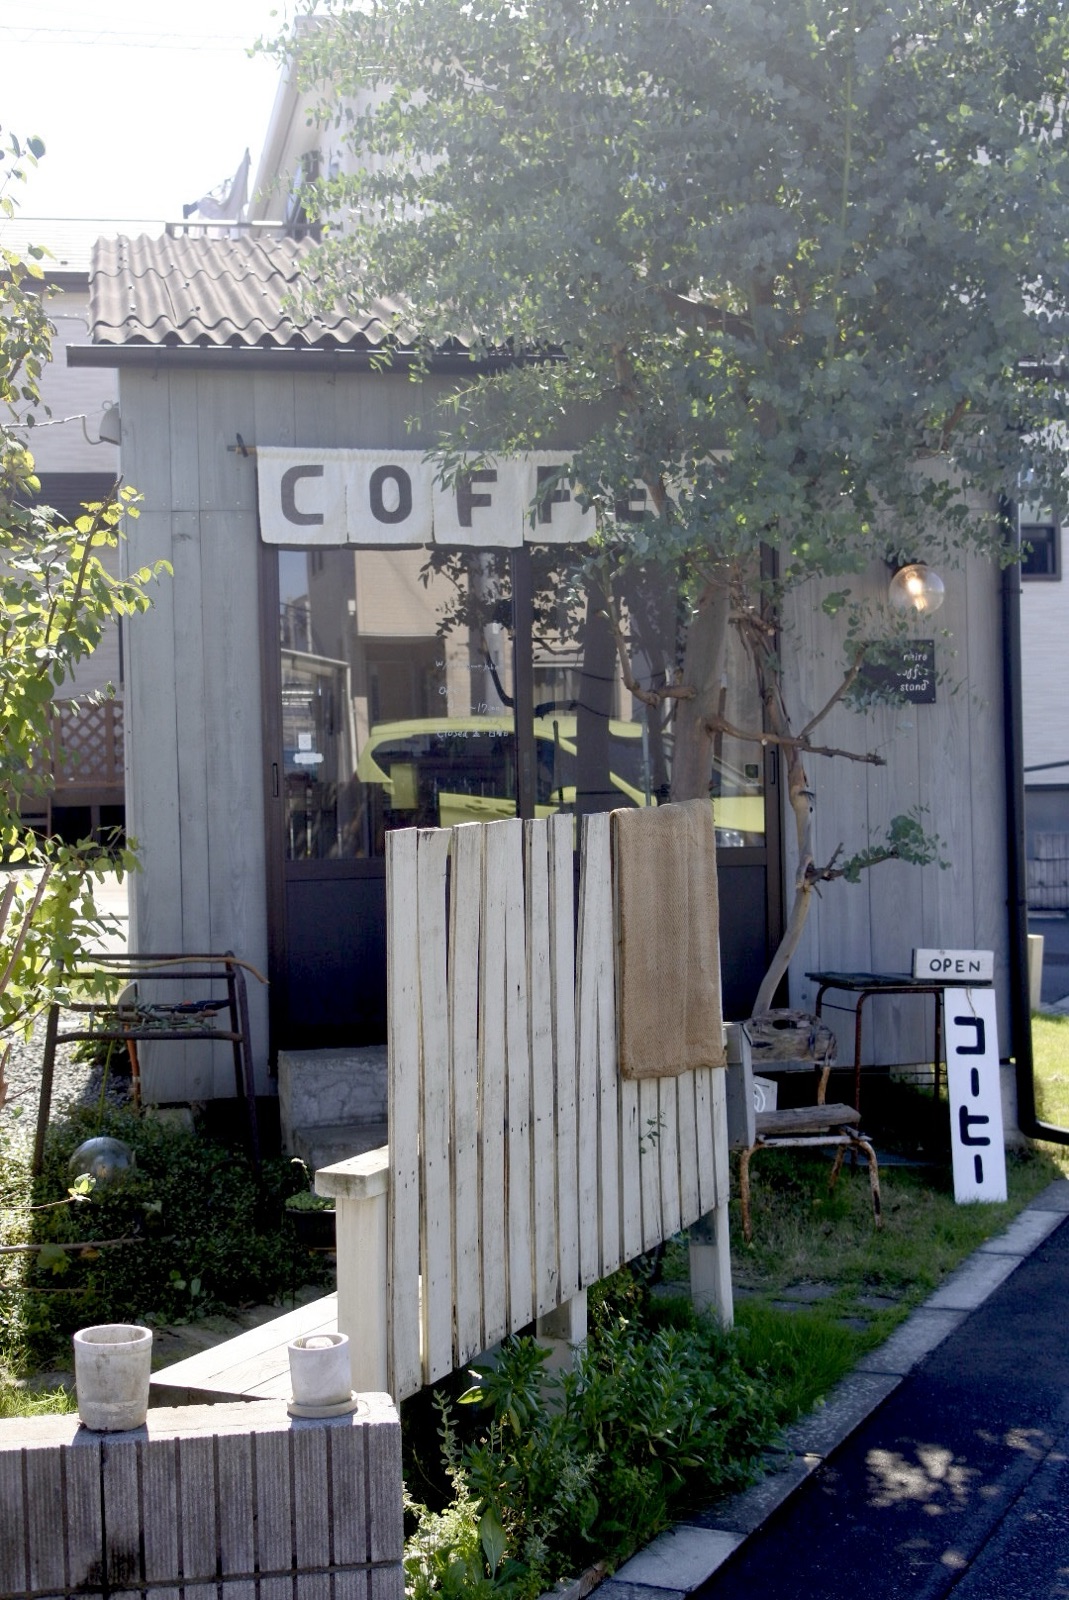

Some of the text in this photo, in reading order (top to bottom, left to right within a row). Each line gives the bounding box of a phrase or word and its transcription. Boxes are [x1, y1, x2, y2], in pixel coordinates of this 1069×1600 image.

[280, 464, 647, 527] COFFE
[900, 680, 929, 691] stand
[929, 958, 981, 973] OPEN
[954, 1016, 991, 1184] コーヒー
